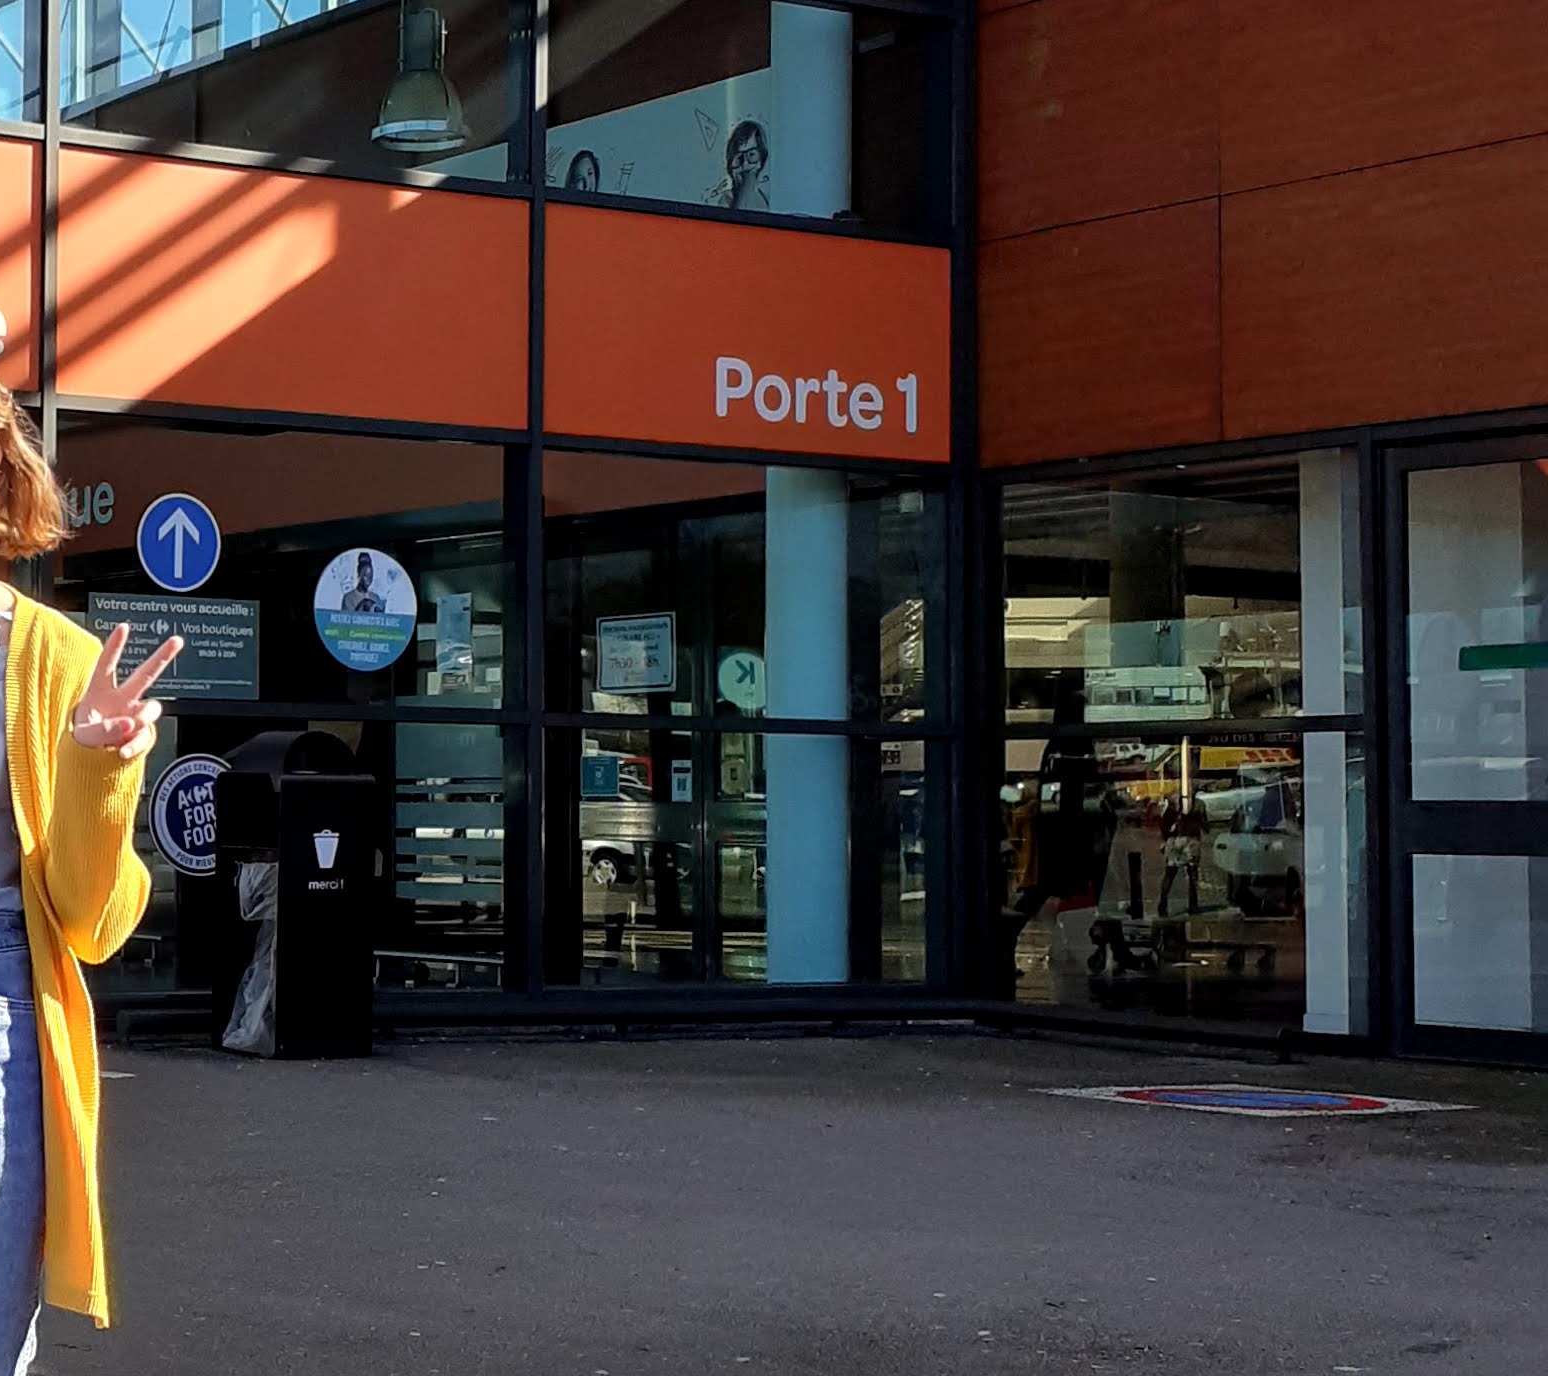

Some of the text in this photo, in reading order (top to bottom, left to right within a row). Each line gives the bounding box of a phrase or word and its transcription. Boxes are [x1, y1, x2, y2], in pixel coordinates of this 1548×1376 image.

[716, 357, 918, 434] Porte 1
[95, 598, 128, 610] Votre
[130, 600, 168, 612] centre
[170, 603, 197, 613] vous
[199, 603, 249, 616] accueille
[181, 622, 254, 637] Vos boutiques
[183, 802, 217, 828] FOR
[183, 822, 218, 849] FOO
[194, 856, 216, 868] MIEU
[308, 878, 339, 890] merci
